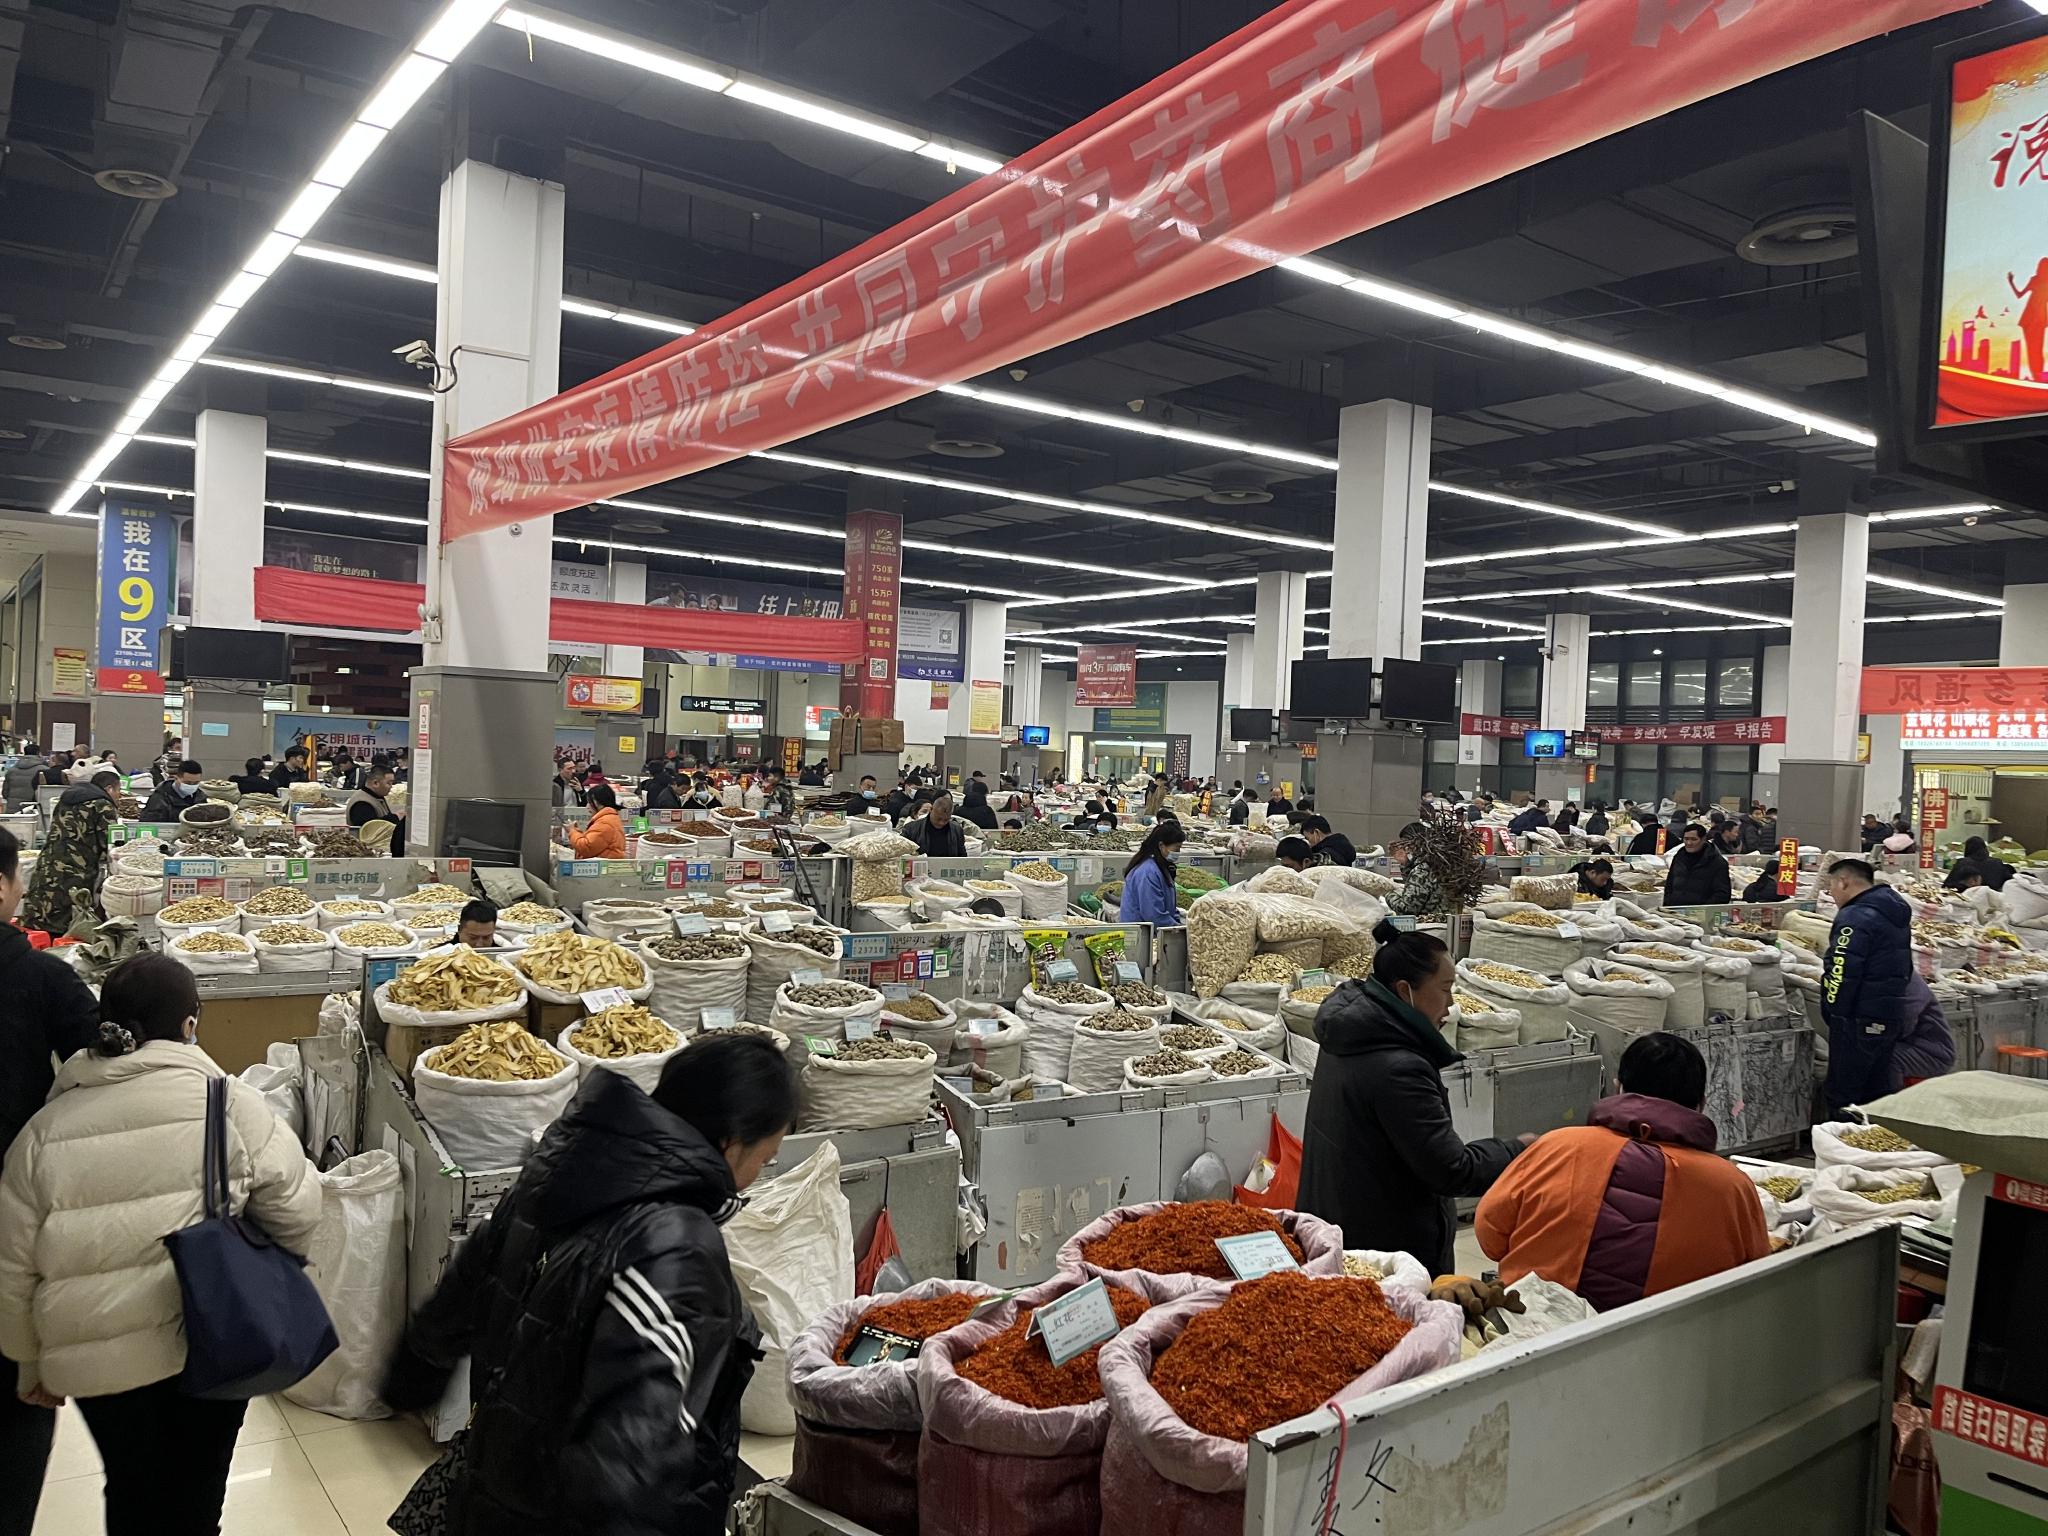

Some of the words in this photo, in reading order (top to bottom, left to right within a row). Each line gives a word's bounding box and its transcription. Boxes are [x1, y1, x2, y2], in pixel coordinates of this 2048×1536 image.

[1678, 724, 1717, 740] 早发现
[1733, 721, 1774, 739] 早报告
[1922, 789, 1946, 828] 佛手
[315, 872, 379, 884] 康美中药城
[1779, 839, 1797, 884] 白鲜皮
[1834, 926, 1854, 955] neo
[1823, 956, 1846, 1004] adidas
